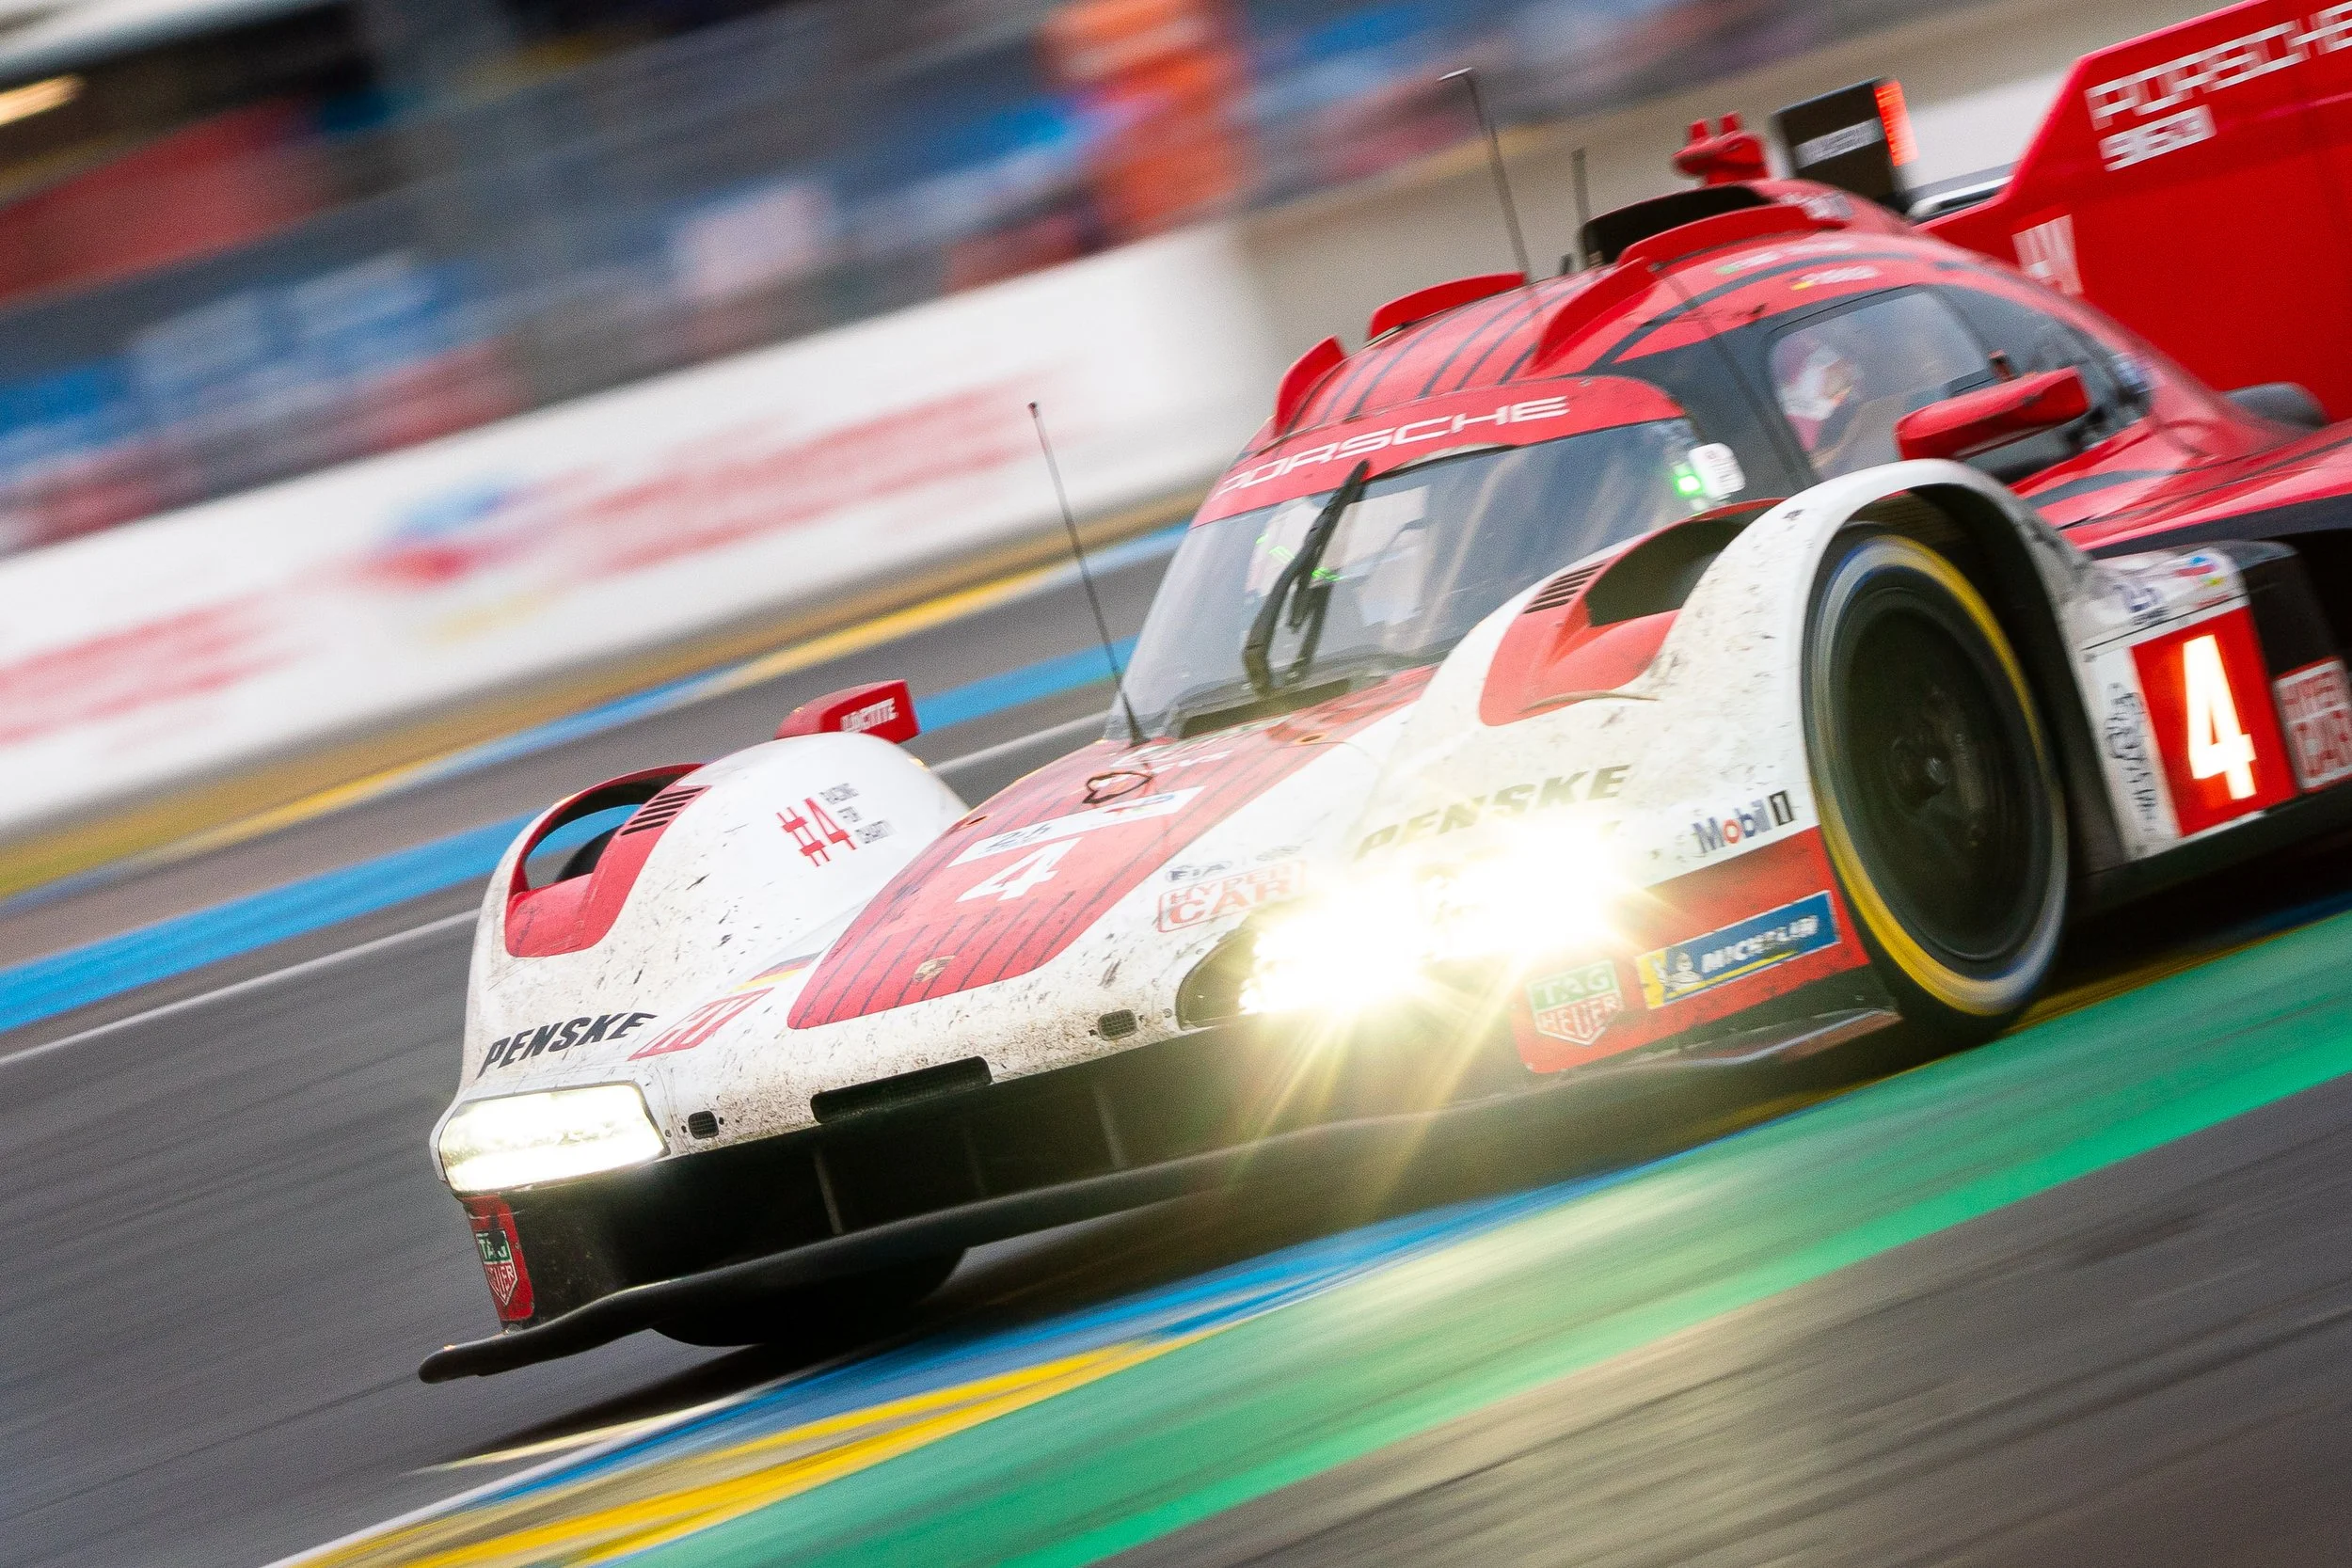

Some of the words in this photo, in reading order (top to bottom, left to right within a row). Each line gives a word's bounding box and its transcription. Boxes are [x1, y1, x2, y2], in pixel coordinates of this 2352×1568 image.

[2083, 1, 2352, 131] PORSCHE
[2098, 103, 2217, 171] 963
[1211, 396, 1570, 500] PORSCHE
[2182, 634, 2257, 800] 4
[776, 798, 857, 866] #4
[1353, 764, 1632, 862] PENSKE
[1692, 800, 1772, 853] Mobil
[955, 837, 1083, 903] 4
[1169, 879, 1293, 924] CAR
[1170, 863, 1293, 905] HYPER
[1533, 968, 1611, 1005] TAG
[1540, 995, 1626, 1038] HEUER
[475, 1012, 659, 1080] PENSKE
